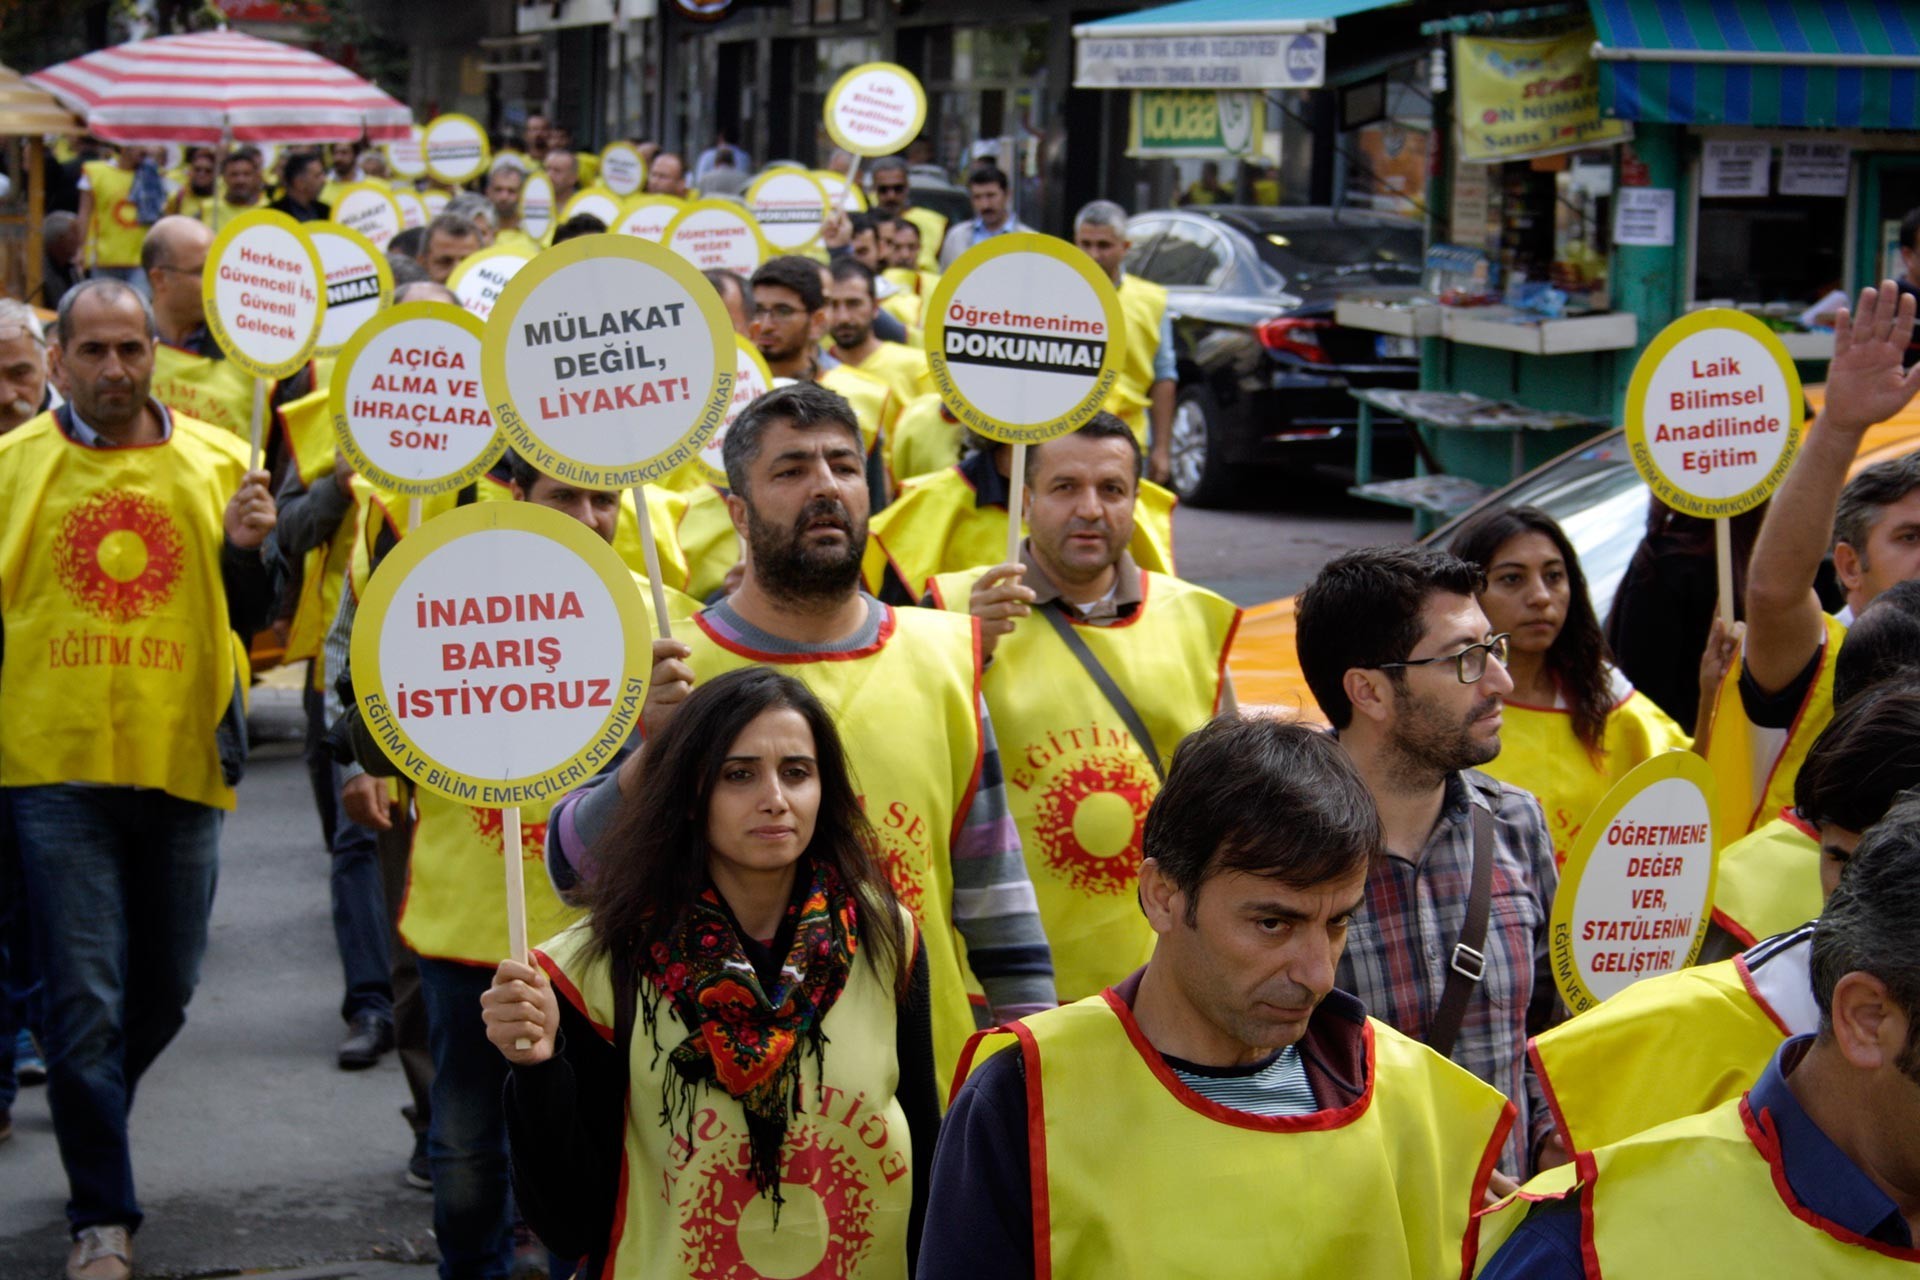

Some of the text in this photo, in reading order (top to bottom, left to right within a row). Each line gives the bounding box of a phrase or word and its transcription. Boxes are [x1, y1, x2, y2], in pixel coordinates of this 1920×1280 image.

[240, 247, 302, 274] Herkese
[219, 265, 295, 296] Güvenceli
[240, 292, 295, 317] Güvenli
[949, 299, 1104, 335] Öğretmenime
[236, 314, 295, 341] Gelecek
[523, 302, 685, 347] MÜLAKAT
[389, 346, 466, 372] AÇIĞA
[553, 340, 667, 381] DEĞİL,
[945, 331, 1103, 369] DOKUNMA!
[1691, 357, 1742, 380] Laik
[371, 374, 478, 399] ALMA VE
[539, 377, 691, 421] LİYAKAT!
[1670, 384, 1764, 412] Bilimsel
[353, 395, 493, 428] İHRAÇLARA
[950, 395, 964, 412] VE
[389, 430, 449, 452] SON!
[496, 403, 535, 453] EĞİTİM
[536, 448, 555, 469] VE
[556, 462, 600, 486] BİLİM
[604, 446, 692, 488] EMEKÇİLERİ
[691, 372, 732, 450] SENDİKASI
[1654, 415, 1781, 443] Anadilinde
[1633, 442, 1661, 485] EĞİTİM
[1658, 481, 1674, 498] VE
[1682, 448, 1758, 474] Eğitim
[416, 591, 584, 629] İNADINA
[49, 628, 187, 673] EĞİTİM SEN
[442, 636, 563, 674] BARIŞ
[397, 678, 613, 719] İSTİYORUZ
[364, 677, 643, 803] EĞİTİM VE BİLİM EMEKÇİLERİ SENDİKASI
[1607, 818, 1708, 846] ÖĞRETMENE
[1626, 851, 1684, 878] DEĞER
[1631, 889, 1668, 912] VER,
[1582, 911, 1694, 942] STATÜLERİNİ
[1554, 922, 1583, 1002] EĞİTİM VE
[1591, 945, 1675, 978] GELİŞTİR!
